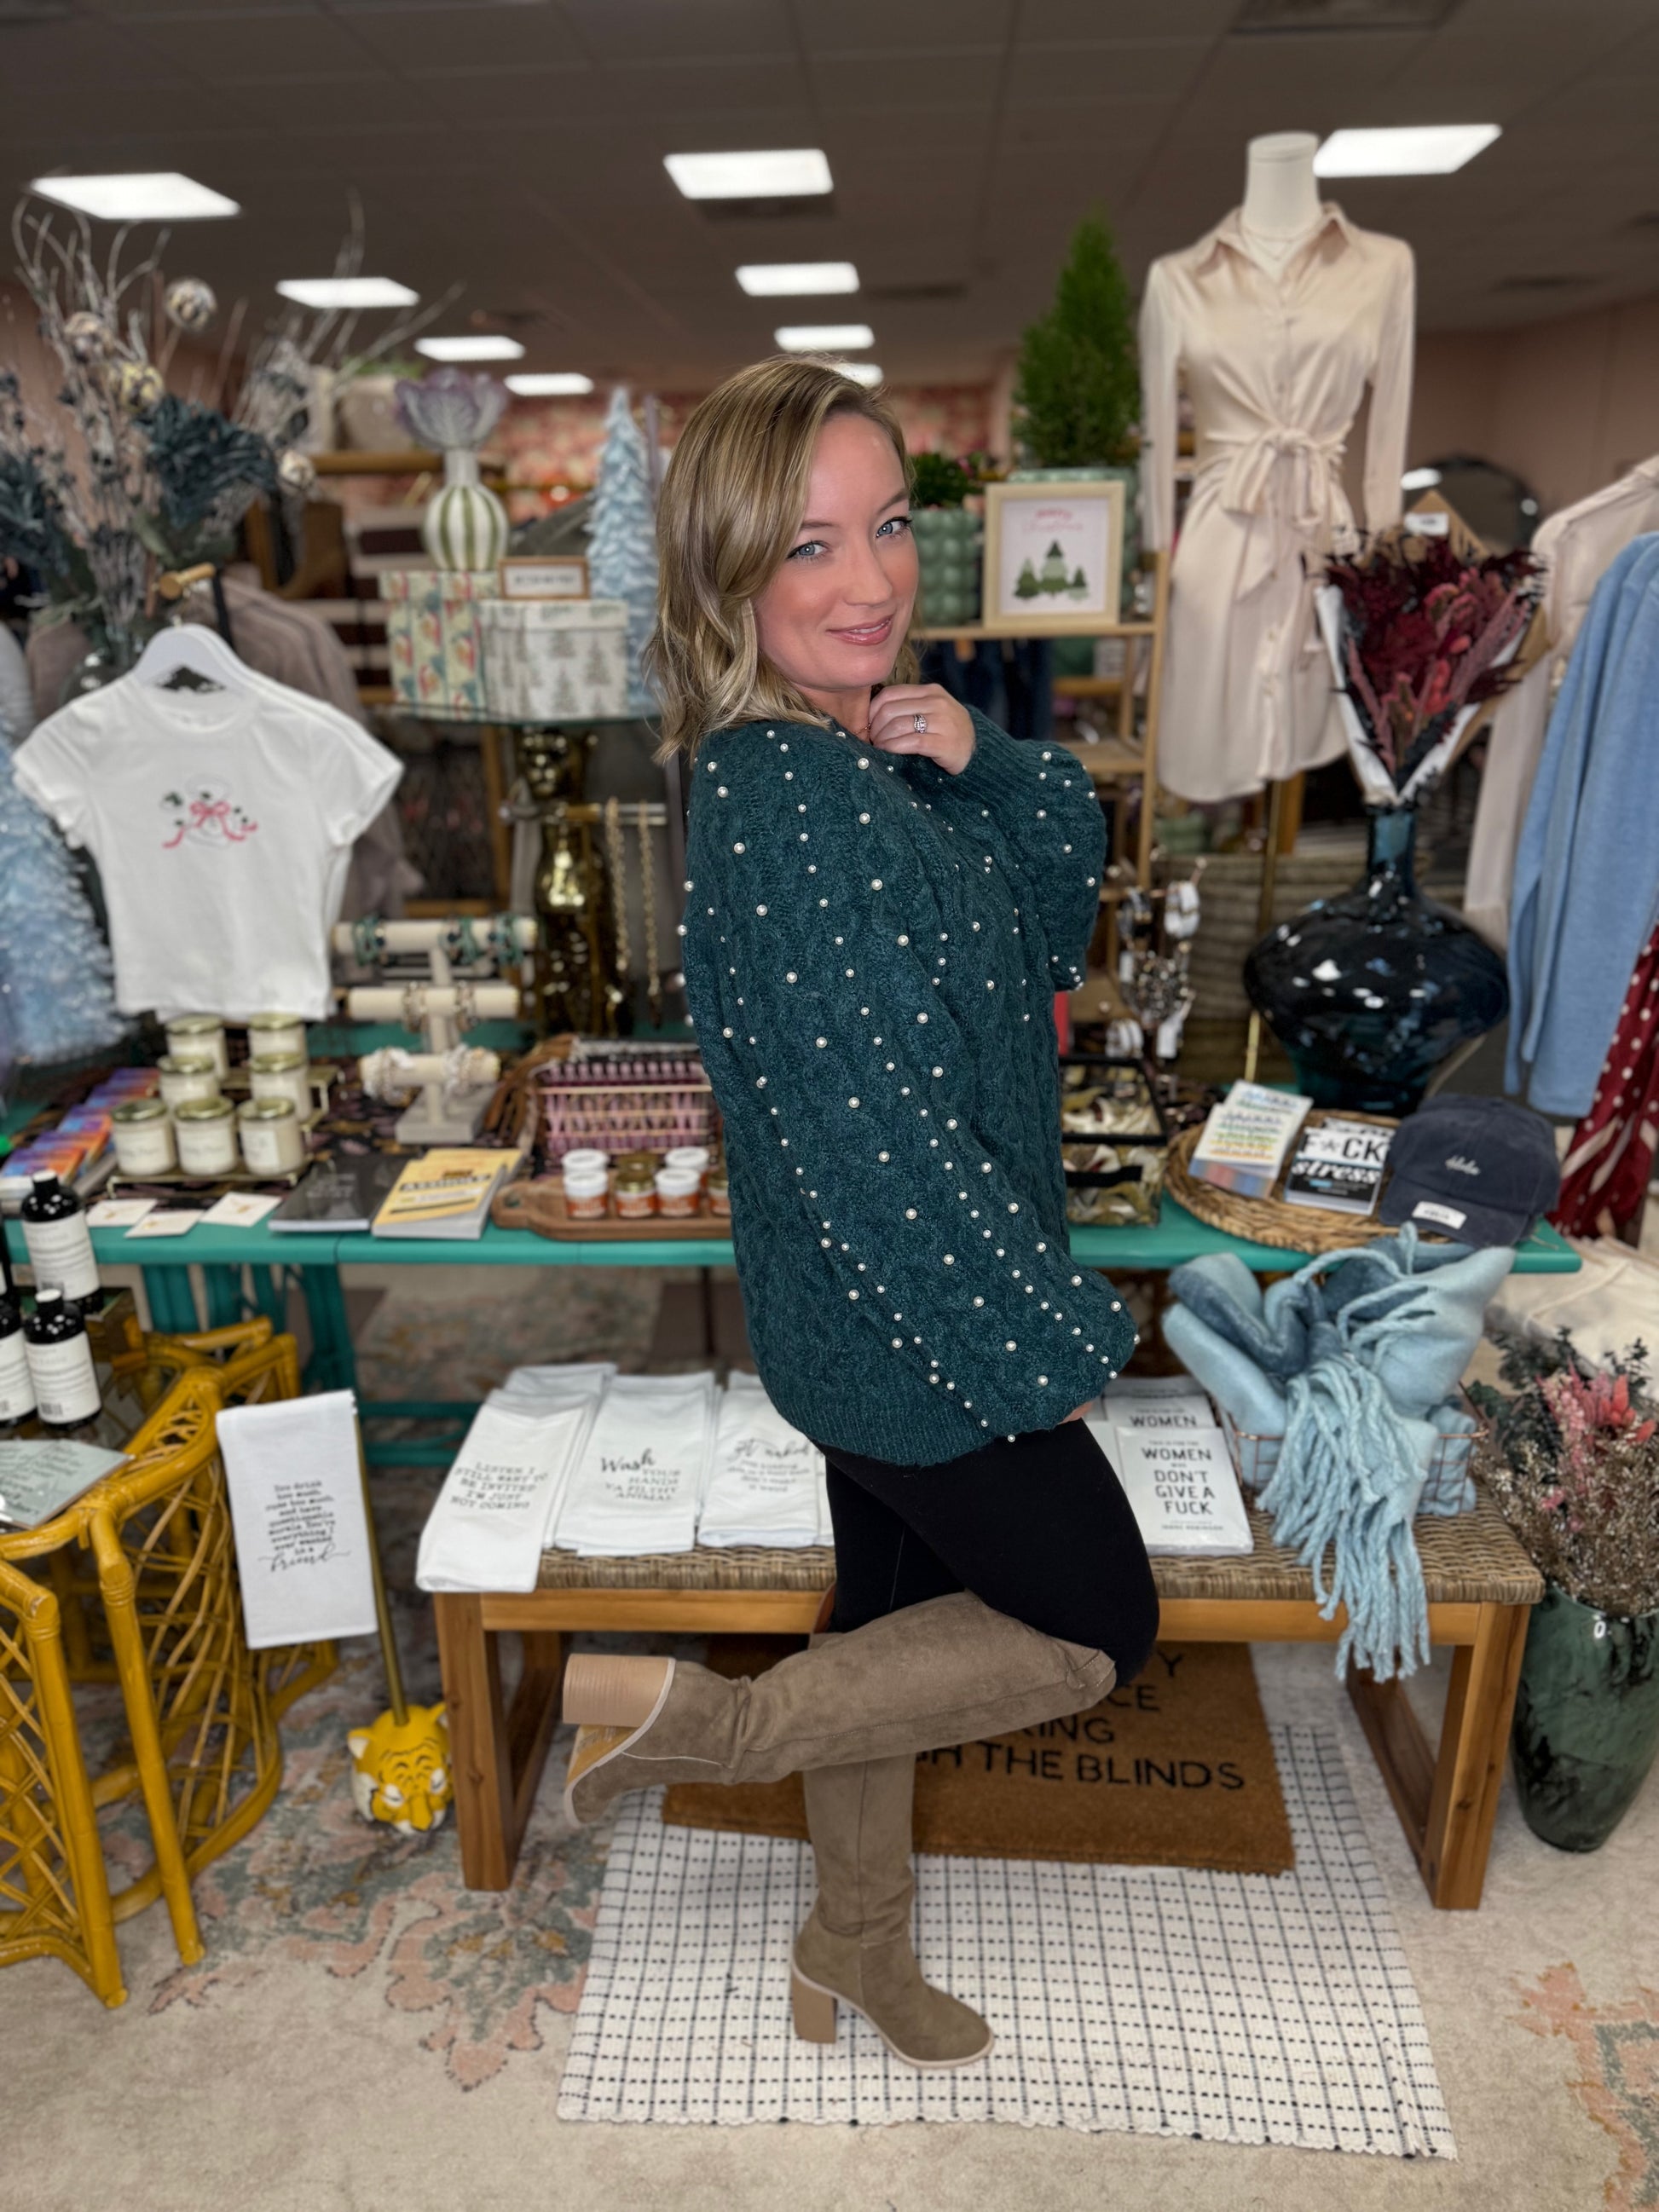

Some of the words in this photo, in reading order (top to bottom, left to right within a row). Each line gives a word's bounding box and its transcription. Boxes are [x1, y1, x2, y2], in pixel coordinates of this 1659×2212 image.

[1292, 1161, 1380, 1184] stress
[1130, 1415, 1196, 1428] WOMEN
[601, 1447, 656, 1472] Wash
[1142, 1447, 1211, 1460] WOMEN
[1153, 1470, 1208, 1483] DON'T
[1155, 1484, 1199, 1499] GIVE
[1203, 1486, 1215, 1499] A
[1164, 1501, 1213, 1515] FUCK
[976, 1740, 1065, 1781] THE
[1076, 1753, 1246, 1791] BLINDS
